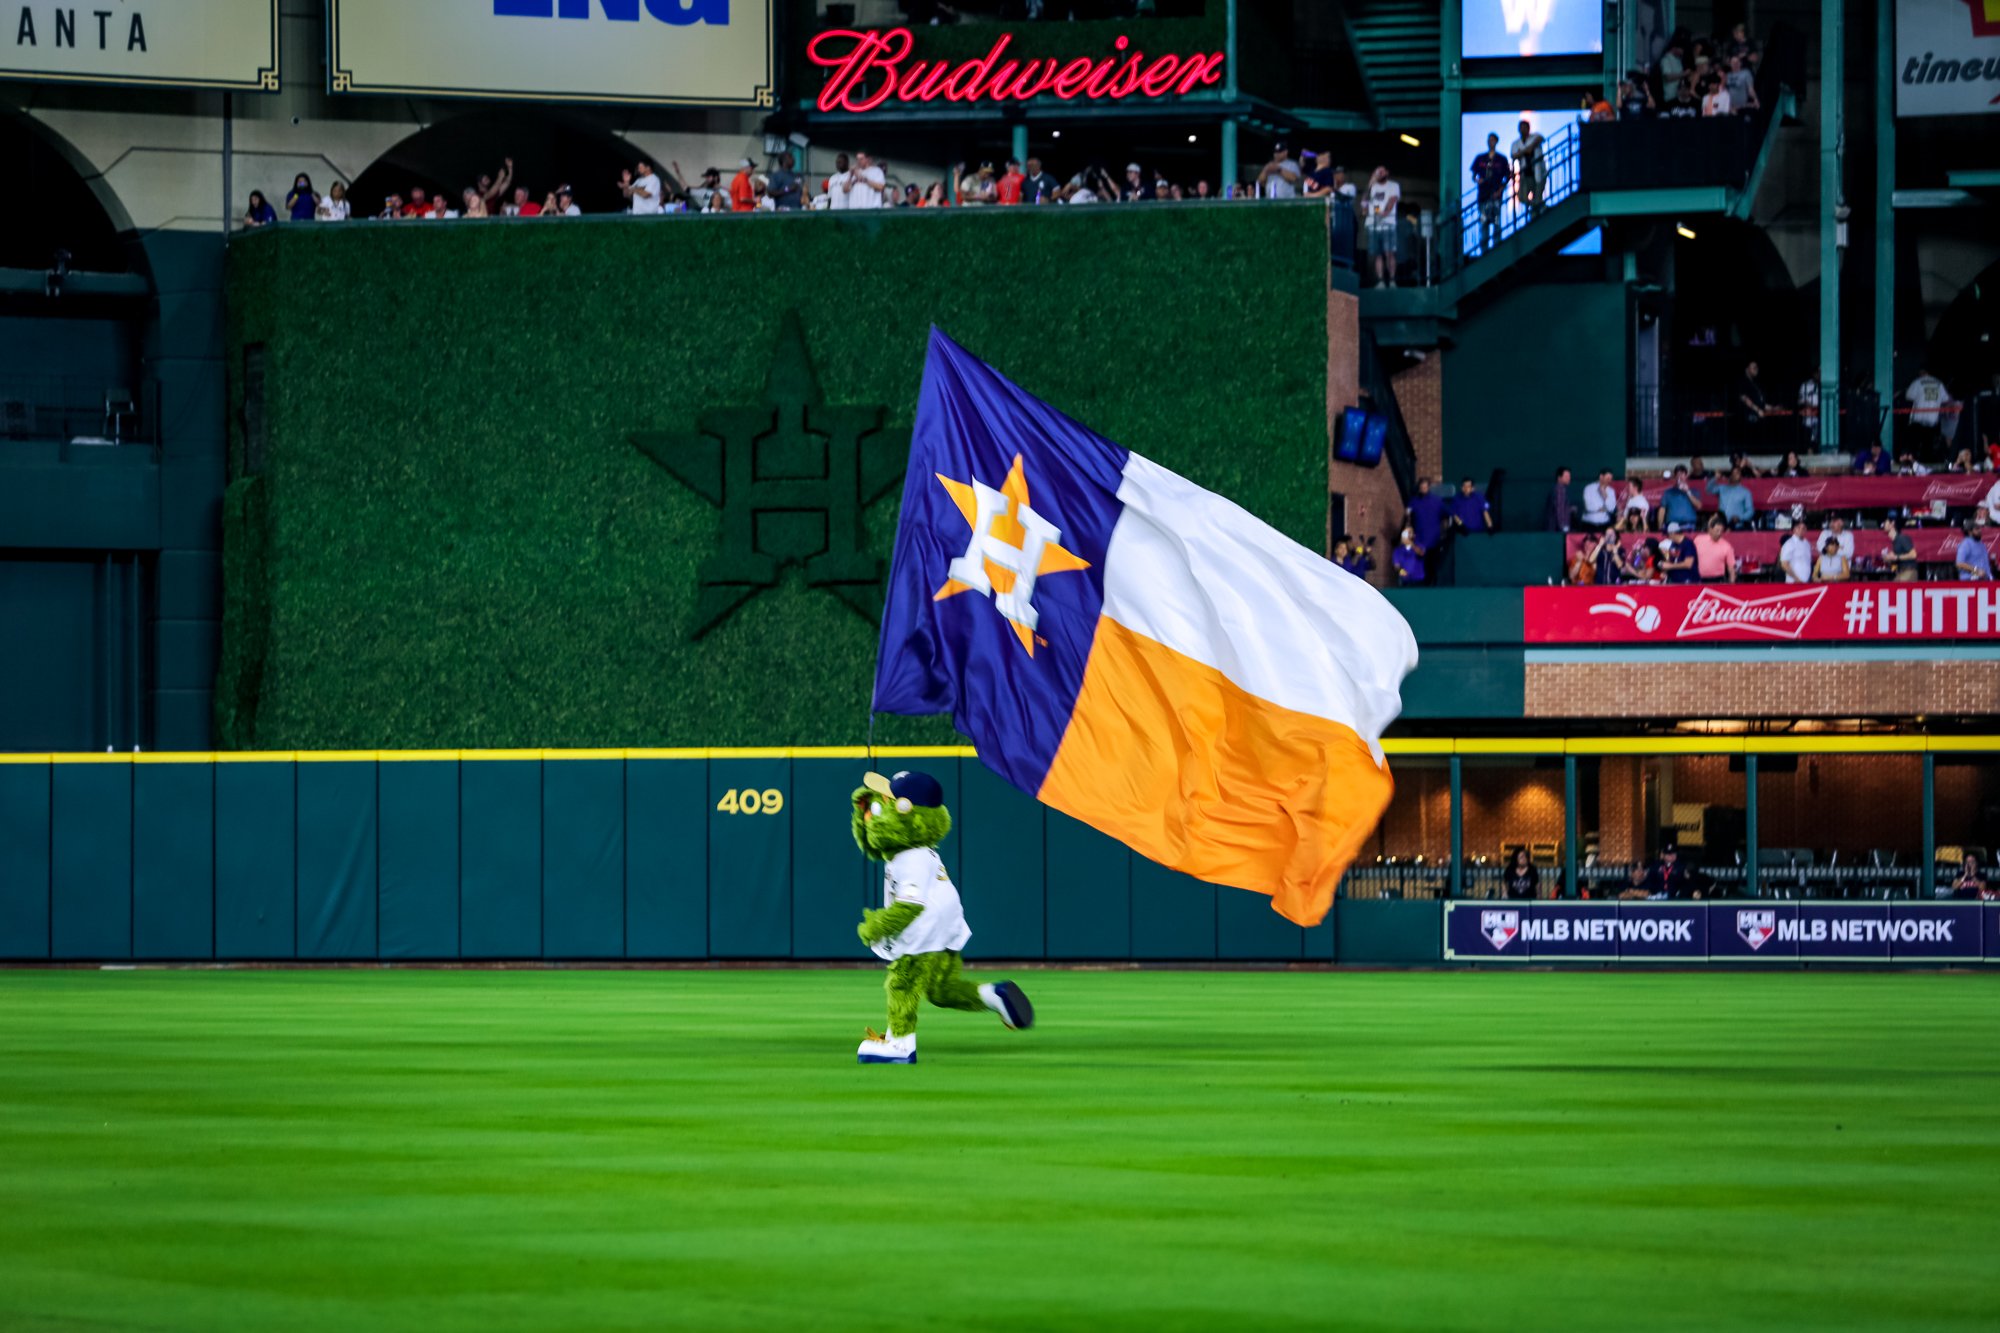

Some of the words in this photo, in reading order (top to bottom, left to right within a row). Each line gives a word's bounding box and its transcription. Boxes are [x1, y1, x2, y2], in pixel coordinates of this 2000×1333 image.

[806, 27, 1225, 112] Budweiser
[1687, 599, 1812, 624] Budweiser
[1844, 588, 2000, 635] #HITTH
[717, 788, 784, 815] 409
[1521, 919, 1569, 942] MLB
[1573, 919, 1692, 942] NETWORK
[1777, 919, 1828, 942] MLB
[1832, 919, 1953, 942] NETWORK
